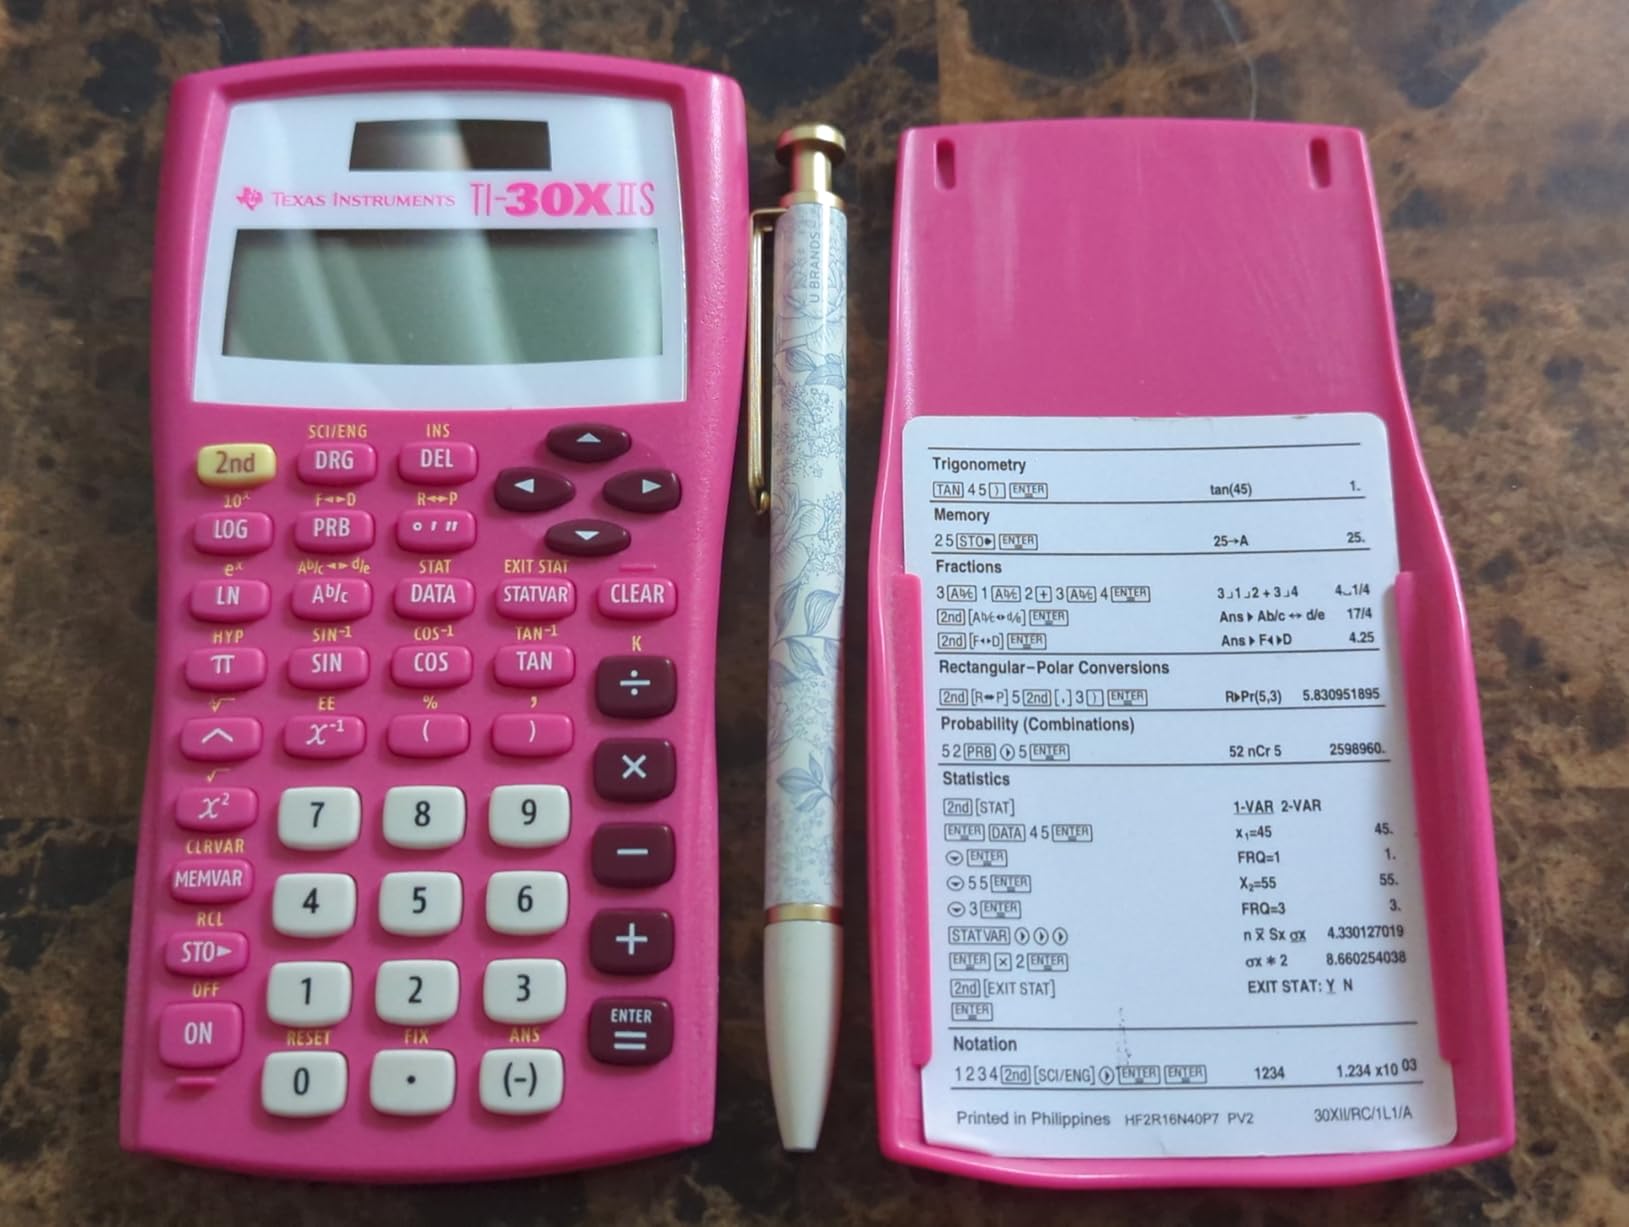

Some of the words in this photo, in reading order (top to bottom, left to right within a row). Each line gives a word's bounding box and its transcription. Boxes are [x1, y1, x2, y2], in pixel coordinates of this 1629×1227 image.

[273, 192, 325, 207] TEXAS
[332, 192, 455, 208] INSTRUMENTS
[810, 232, 820, 288] BRANDS
[810, 295, 820, 303] U
[308, 424, 367, 438] SCI/ENG
[427, 424, 450, 437] INS
[216, 451, 255, 473] 2nd
[315, 451, 353, 469] DRG
[421, 449, 453, 468] DEL
[933, 457, 1026, 473] Trigonometry
[937, 484, 960, 495] TAN
[1013, 485, 1045, 494] ENTER
[1210, 483, 1252, 497] tan(45)
[1350, 481, 1360, 491] 1.
[935, 508, 990, 525] Memory
[214, 520, 247, 539] LOG
[313, 518, 350, 536] PRB
[1003, 536, 1034, 545] ENTER
[1347, 532, 1365, 543] 25.
[419, 560, 451, 573] STAT
[504, 560, 534, 573] EXIT
[539, 560, 568, 573] STAT
[936, 560, 1002, 573] Fractions
[217, 586, 240, 605] LN
[411, 583, 456, 603] DATA
[504, 585, 568, 602] STATVAR
[611, 584, 664, 603] CLEAR
[1115, 589, 1146, 598] ENTER
[941, 611, 962, 623] 2nd
[1033, 612, 1065, 621] ENTER
[1220, 612, 1243, 623] Ans
[1258, 610, 1285, 621] Ab/c
[1307, 609, 1325, 621] d/e
[1348, 608, 1372, 619] 17/4
[213, 630, 244, 644] HYP
[632, 636, 641, 651] K
[942, 634, 963, 646] 2nd
[1011, 635, 1043, 645] ENTER
[1222, 636, 1246, 647] Ans
[1349, 632, 1374, 643] 4.25
[312, 653, 342, 673] SIN
[414, 652, 448, 672] COS
[516, 652, 552, 670] TAN
[1079, 661, 1169, 674] Conversions
[943, 691, 965, 703] 2nd
[1027, 691, 1048, 704] 2nd
[1111, 692, 1144, 701] ENTER
[1303, 688, 1379, 701] 5.830951895
[319, 697, 335, 710] EE
[942, 717, 1018, 733] Probability
[1023, 717, 1134, 734] (Combinations)
[967, 746, 992, 758] PRB
[1033, 746, 1066, 755] ENTER
[1229, 746, 1244, 757] 52
[1248, 745, 1270, 757] nCr
[1275, 745, 1281, 756] 5
[1330, 742, 1386, 755] 2598960.
[943, 771, 1010, 786] Statistics
[414, 801, 430, 826] 8
[521, 799, 537, 825] 9
[947, 801, 969, 813] 2nd
[1234, 800, 1274, 814] 1-VAR
[1281, 800, 1321, 812] 2-VAR
[311, 802, 324, 828] 7
[948, 825, 981, 835] ENTER
[992, 826, 1022, 839] DATA
[1056, 826, 1089, 836] ENTER
[1375, 823, 1394, 835] 45.
[186, 839, 244, 854] CLRVAR
[970, 851, 1004, 861] ENTER
[1238, 851, 1280, 863] FRQ=1
[1385, 848, 1396, 860] 1.
[175, 870, 242, 887] MEMVAR
[994, 877, 1028, 887] ENTER
[1380, 874, 1399, 885] 55.
[303, 888, 319, 914] 4
[413, 887, 426, 913] 5
[518, 885, 533, 912] 6
[984, 903, 1018, 912] ENTER
[1242, 902, 1286, 915] FRQ=3
[1390, 899, 1401, 911] 3.
[196, 912, 223, 927] RCL
[1269, 928, 1285, 940] Sx
[1328, 925, 1404, 939] 4.330127019
[953, 955, 987, 965] ENTER
[1031, 955, 1064, 965] ENTER
[1326, 951, 1406, 966] 8.660254038
[192, 984, 219, 997] OFF
[301, 978, 311, 1004] 1
[409, 977, 422, 1003] 2
[517, 975, 530, 1002] 3
[954, 982, 978, 994] 2nd
[1248, 980, 1277, 993] EXIT
[1282, 980, 1322, 993] STAT:
[1327, 979, 1335, 994] Y
[1344, 979, 1352, 991] N
[611, 1009, 652, 1023] ENTER
[955, 1005, 989, 1014] ENTER
[184, 1022, 212, 1044] ON
[287, 1032, 329, 1046] RESET
[405, 1030, 428, 1044] FIX
[510, 1029, 539, 1043] ANS
[954, 1036, 1017, 1052] Notation
[1004, 1068, 1027, 1082] 2nd
[1122, 1068, 1156, 1078] ENTER
[1168, 1067, 1203, 1077] ENTER
[1256, 1066, 1285, 1080] 1234
[1337, 1064, 1371, 1078] 1.234
[294, 1068, 309, 1095] 0
[957, 1112, 1009, 1125] Printed
[1014, 1111, 1026, 1125] in
[1032, 1111, 1111, 1128] Philippines
[1125, 1113, 1218, 1126] HF2R16N40P7
[1227, 1113, 1254, 1125] PV2
